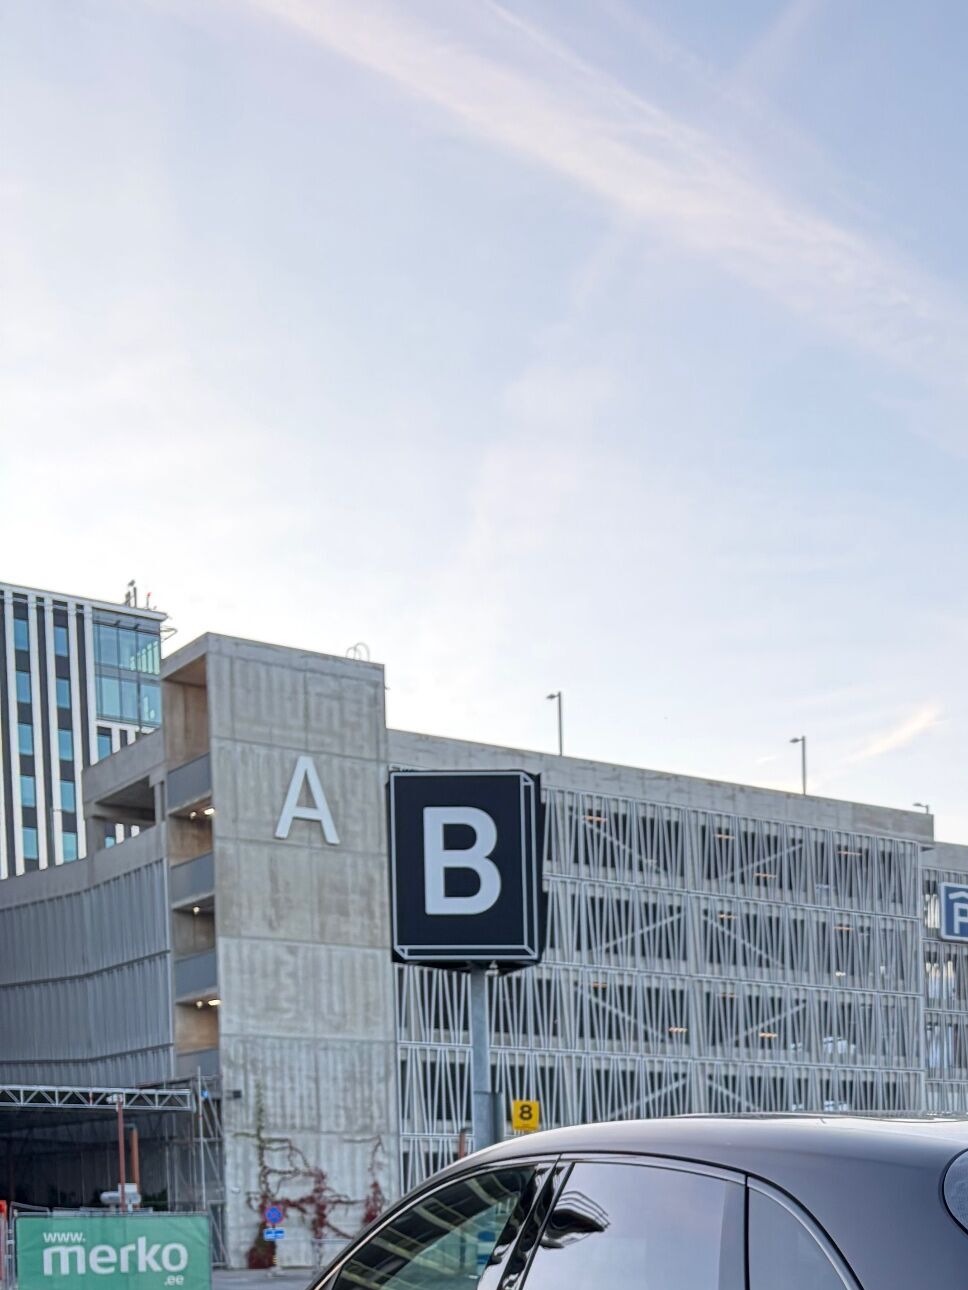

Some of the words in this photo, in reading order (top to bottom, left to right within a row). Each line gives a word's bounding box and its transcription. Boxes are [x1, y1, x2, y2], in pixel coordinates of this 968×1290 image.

[275, 756, 340, 844] A
[423, 806, 501, 915] B
[519, 1104, 533, 1121] 8
[43, 1231, 86, 1243] www.
[43, 1236, 189, 1276] merko
[164, 1274, 185, 1286] .ee
